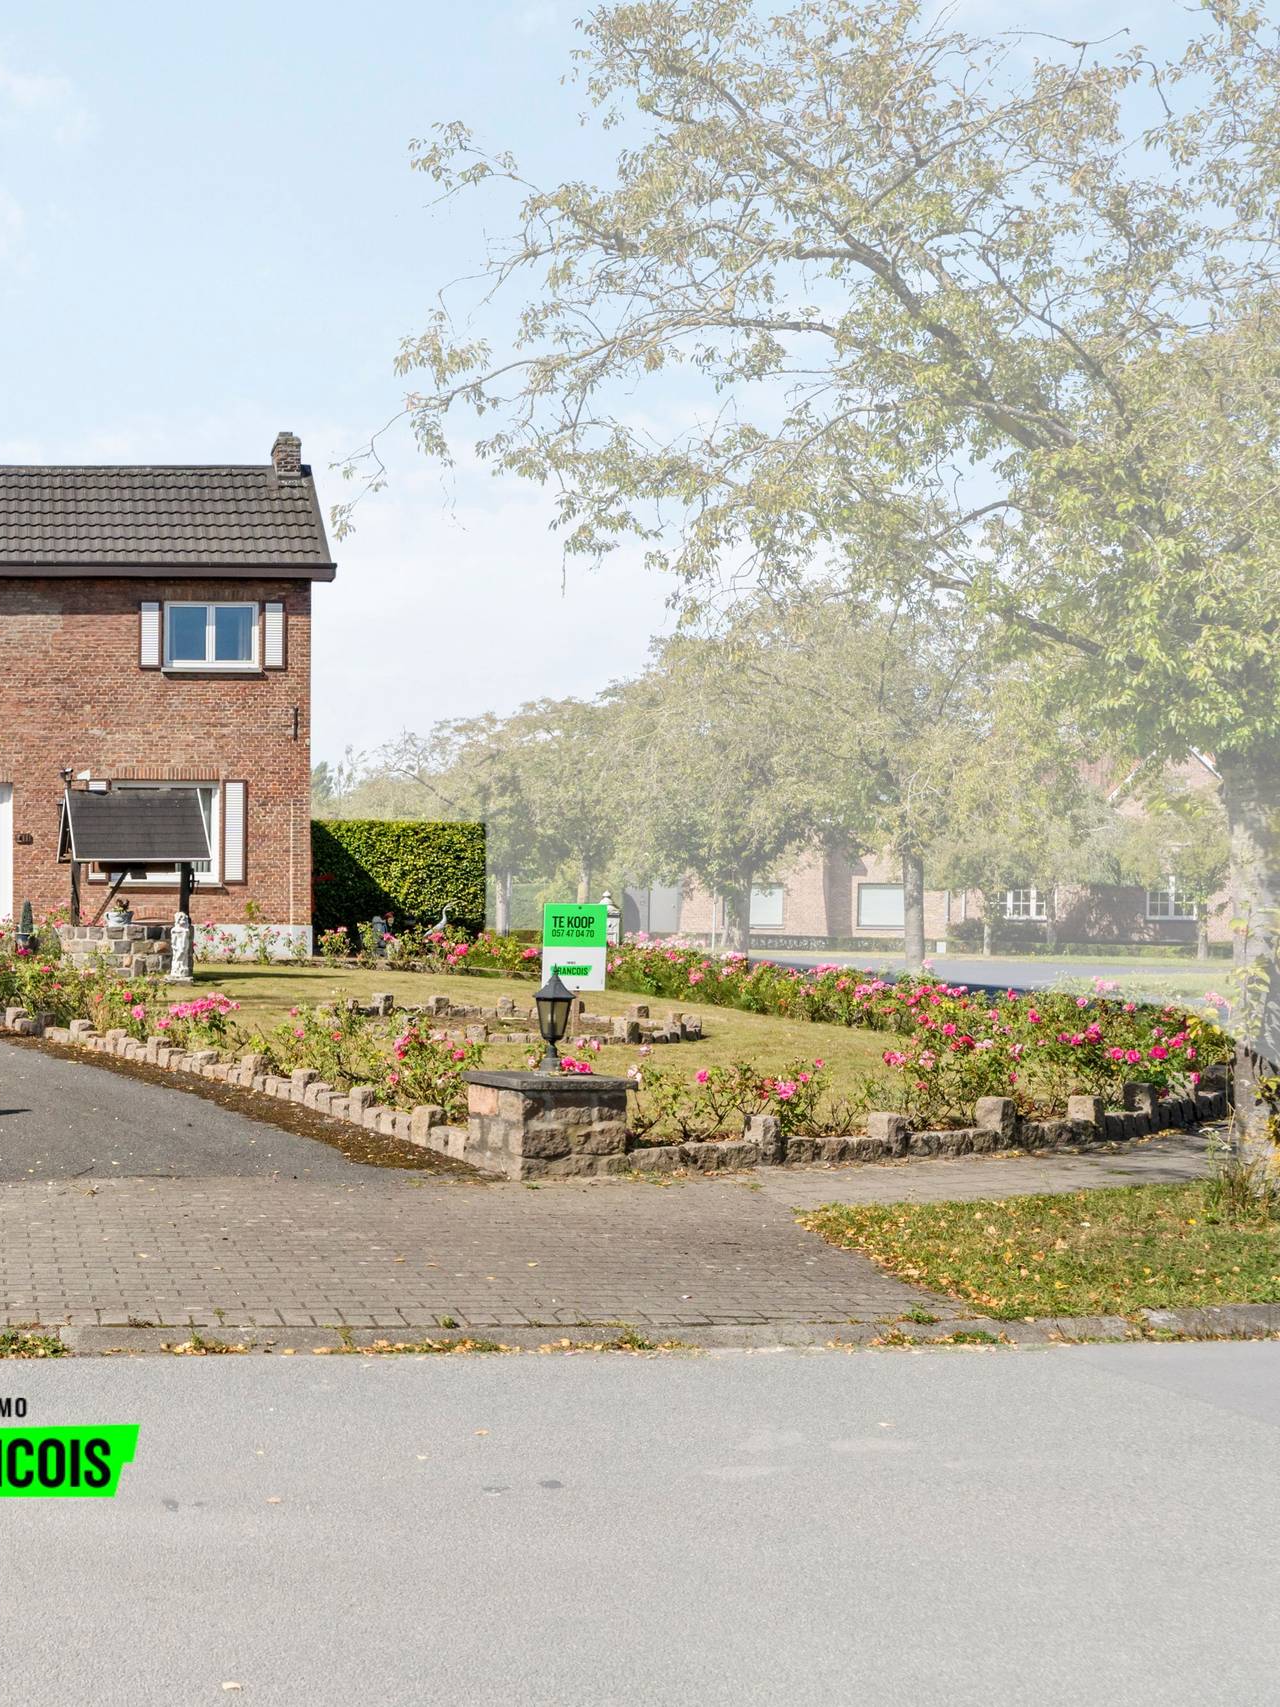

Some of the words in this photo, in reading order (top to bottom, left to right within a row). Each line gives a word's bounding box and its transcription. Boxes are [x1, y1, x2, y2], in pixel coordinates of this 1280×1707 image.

[552, 916, 565, 928] TE
[567, 916, 595, 929] KOOP
[552, 929, 564, 937] 057
[566, 929, 574, 937] 47
[576, 929, 584, 937] 04
[554, 967, 589, 976] RANCOIS
